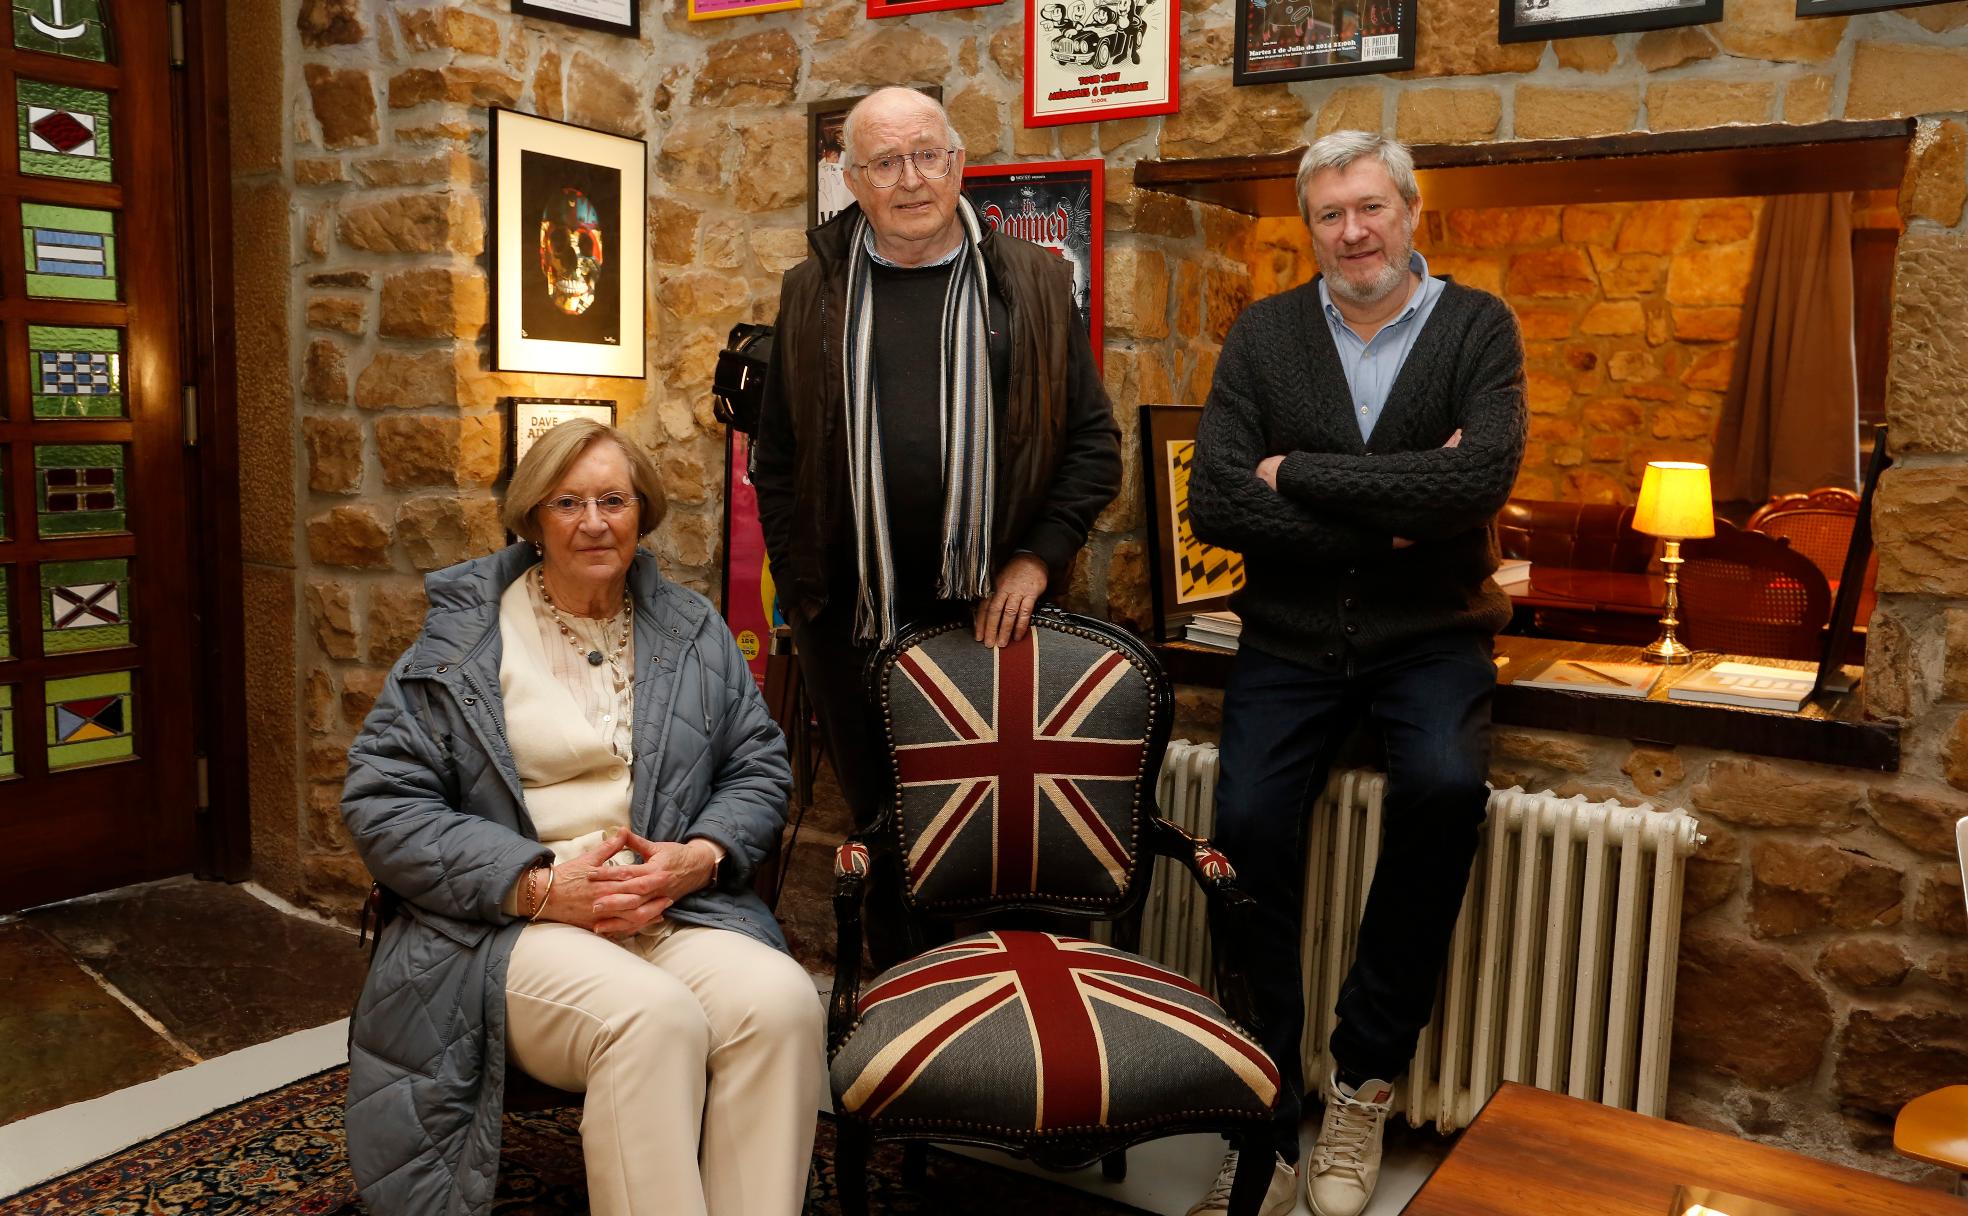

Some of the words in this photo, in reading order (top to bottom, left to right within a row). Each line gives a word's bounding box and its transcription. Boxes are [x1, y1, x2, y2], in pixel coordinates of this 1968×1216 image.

[1372, 36, 1388, 47] PATIO
[1249, 49, 1272, 57] Martes
[1287, 45, 1305, 53] Julio
[1315, 42, 1332, 50] 2014
[1371, 45, 1396, 57] FAVORITA
[1078, 74, 1100, 85] TOUR
[1092, 86, 1099, 96] 6
[984, 201, 1070, 243] Damned
[531, 416, 558, 426] DAVE
